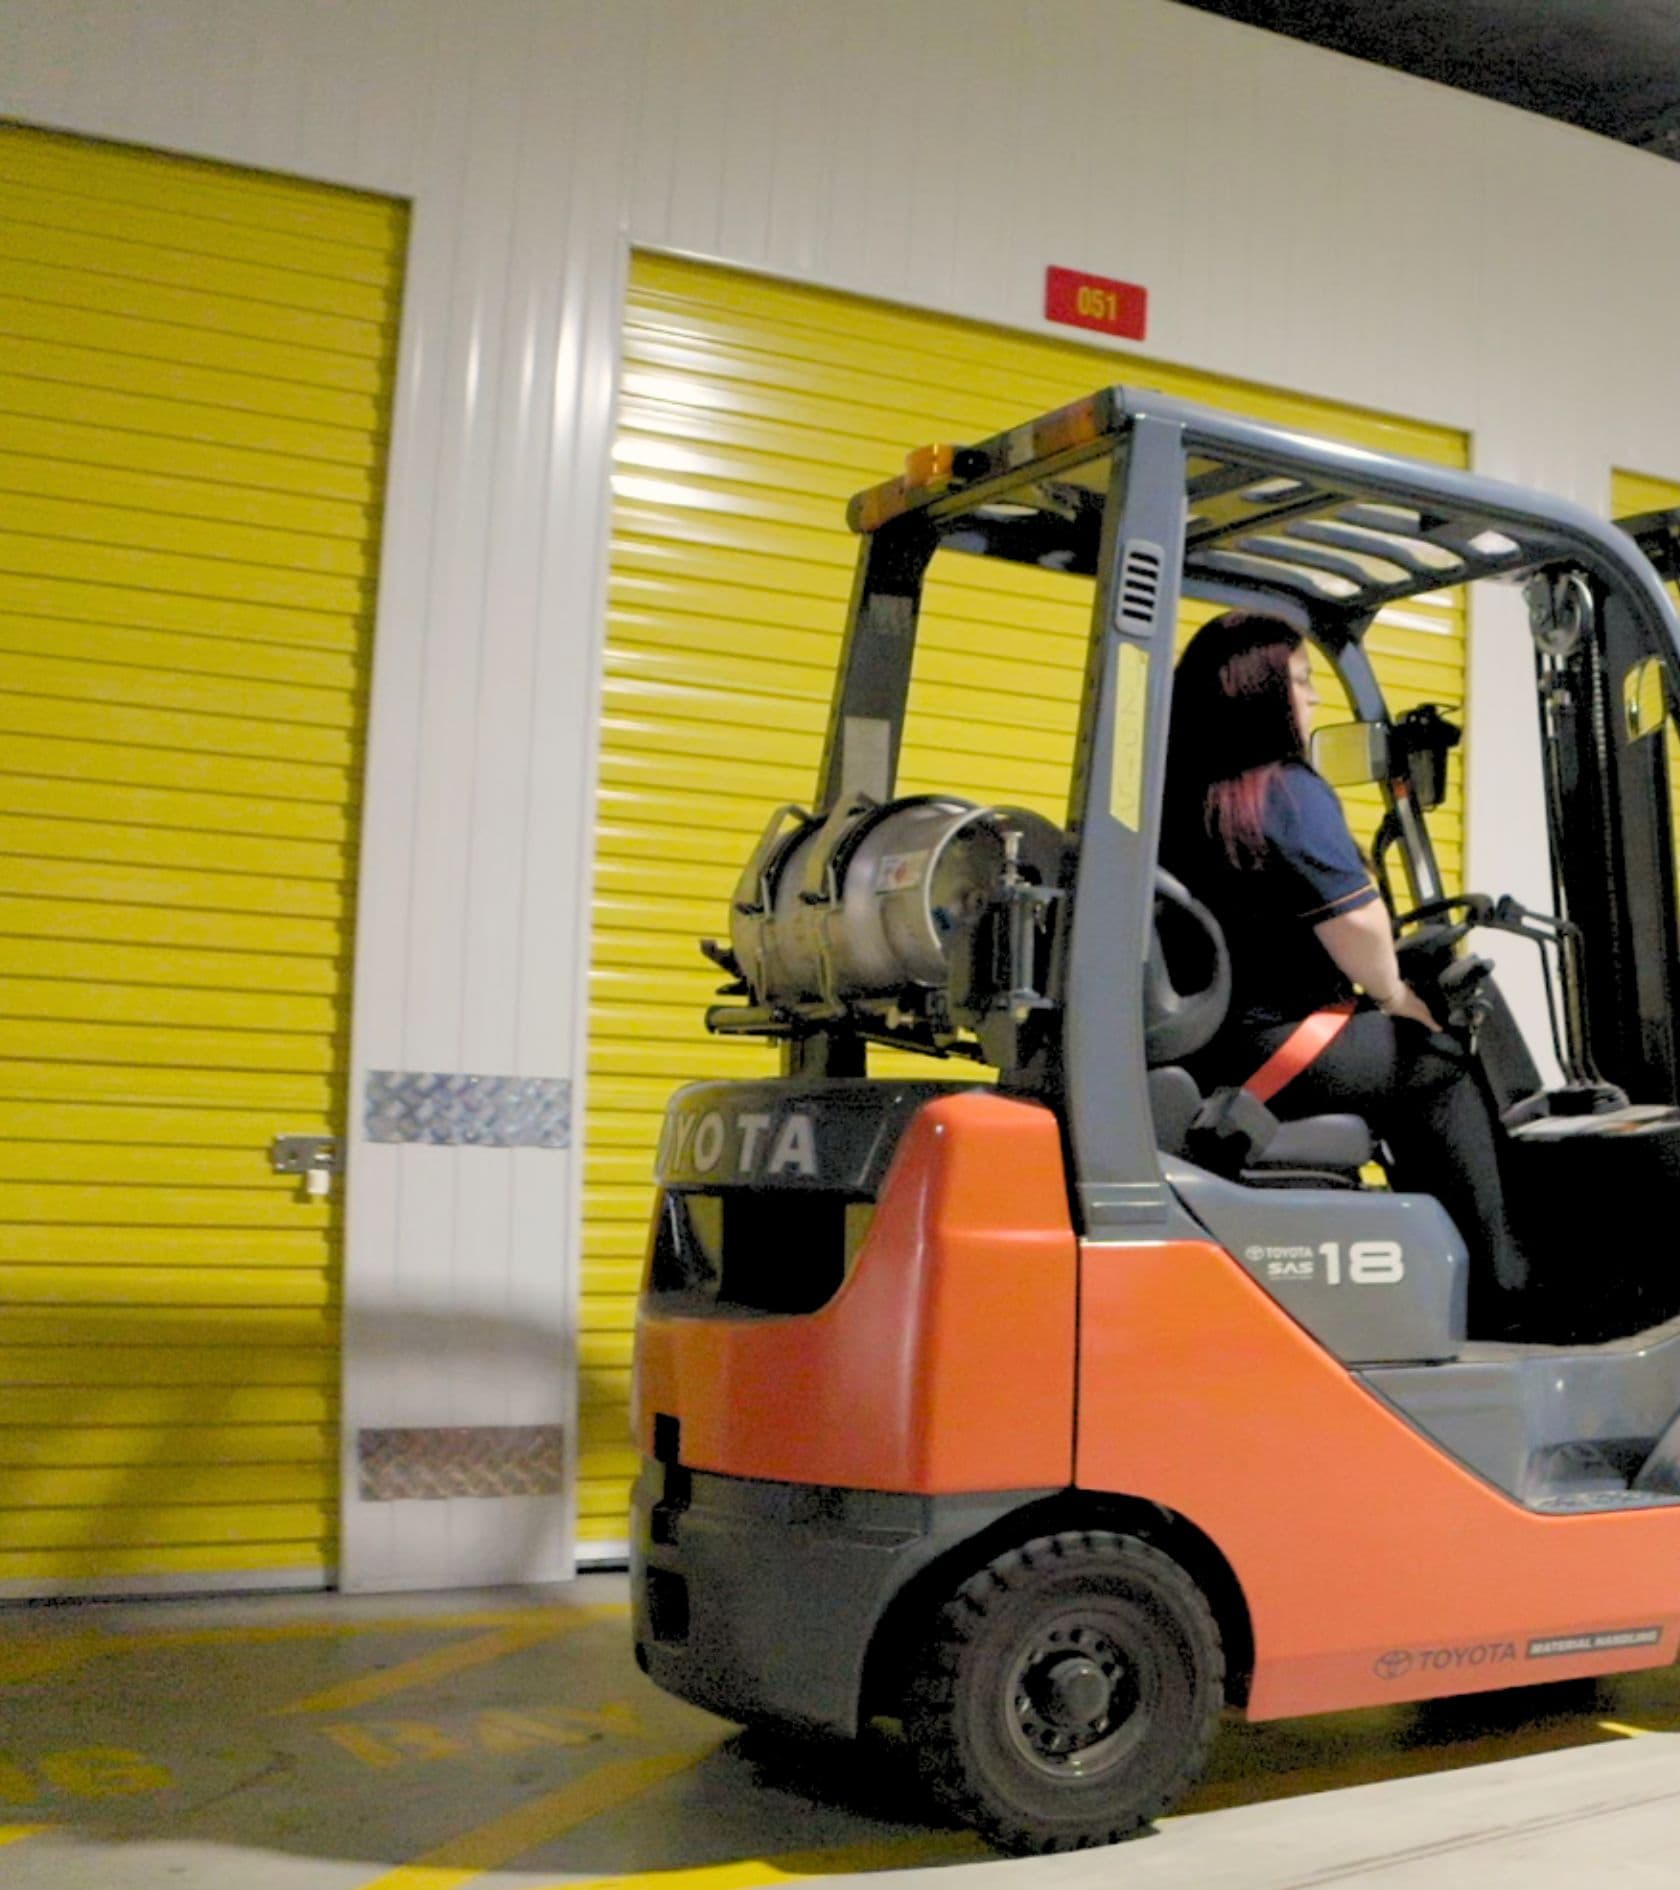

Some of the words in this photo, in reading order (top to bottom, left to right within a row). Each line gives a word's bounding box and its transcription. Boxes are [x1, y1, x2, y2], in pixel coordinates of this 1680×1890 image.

[1077, 285, 1117, 321] 051
[1266, 1247, 1313, 1259] TOYOTA
[1319, 1241, 1404, 1285] 18
[1420, 1641, 1517, 1670] TOYOTA
